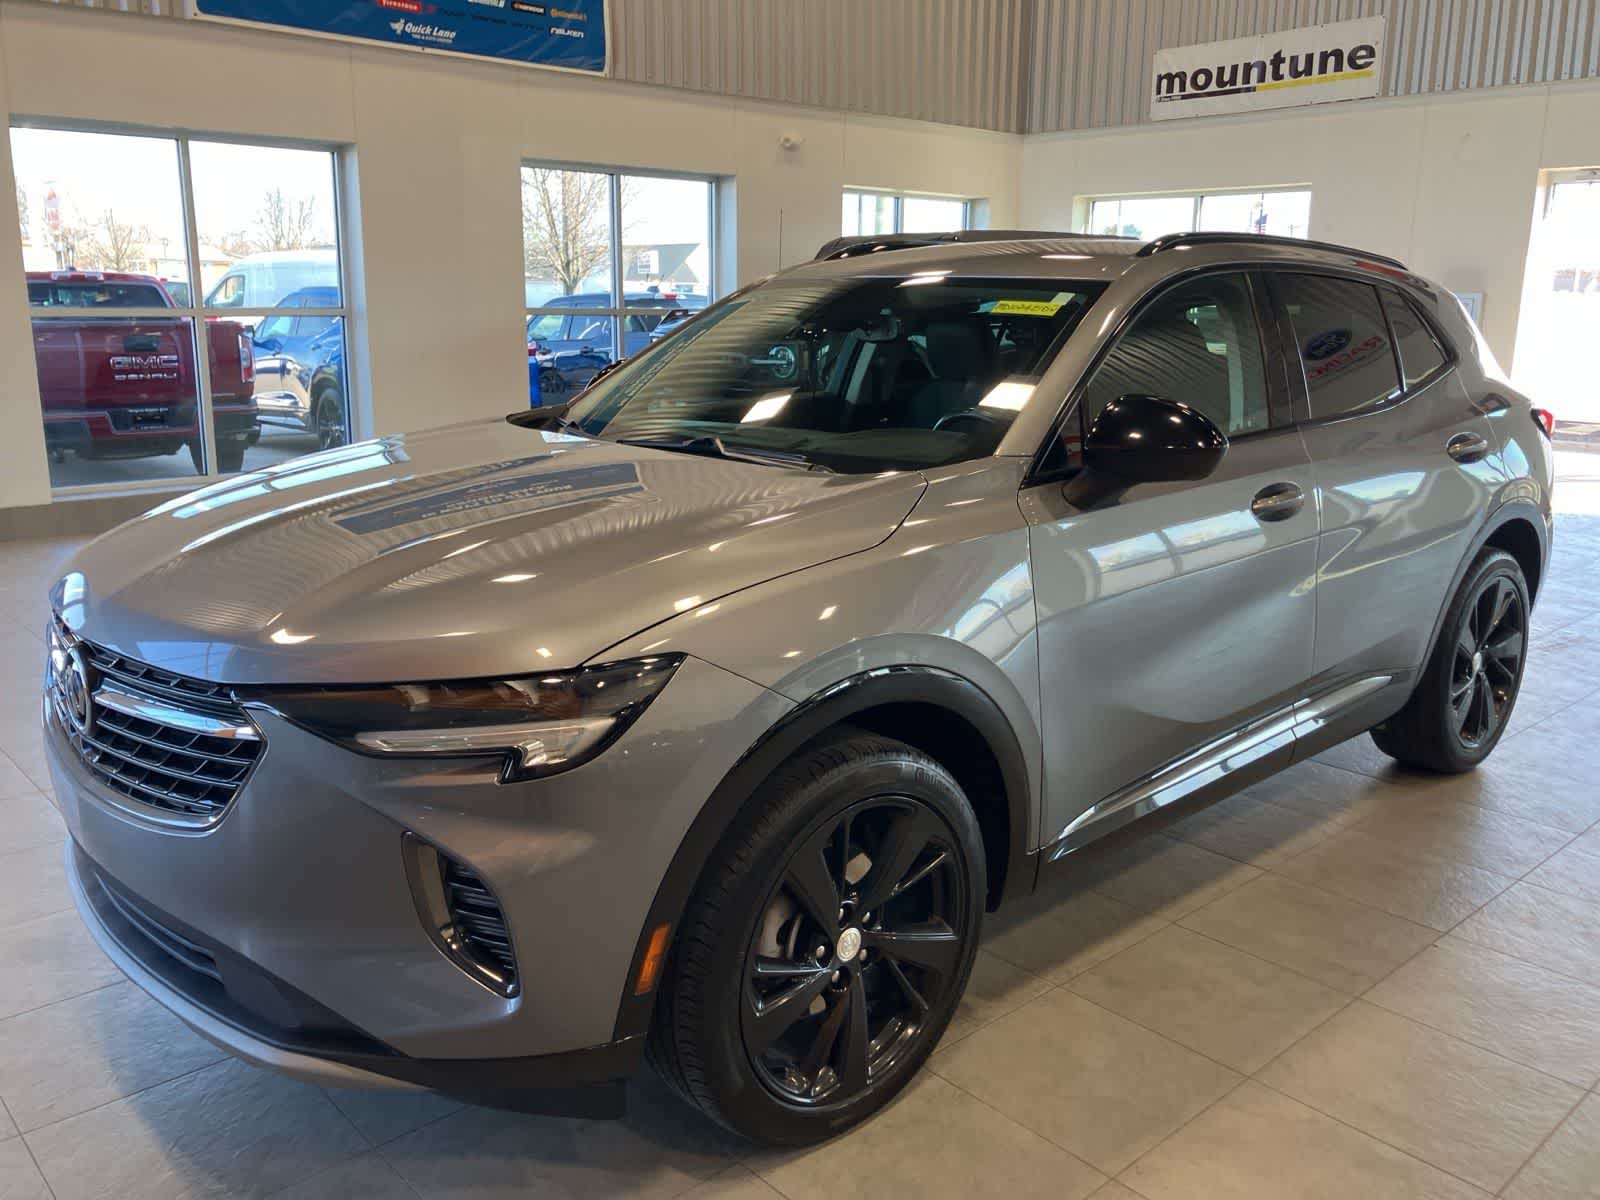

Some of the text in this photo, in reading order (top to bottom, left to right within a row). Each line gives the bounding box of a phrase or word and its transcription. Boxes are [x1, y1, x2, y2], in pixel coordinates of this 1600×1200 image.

[405, 22, 432, 34] Quick
[432, 27, 457, 39] Lane
[1156, 44, 1376, 95] mountune
[110, 355, 177, 369] GMC
